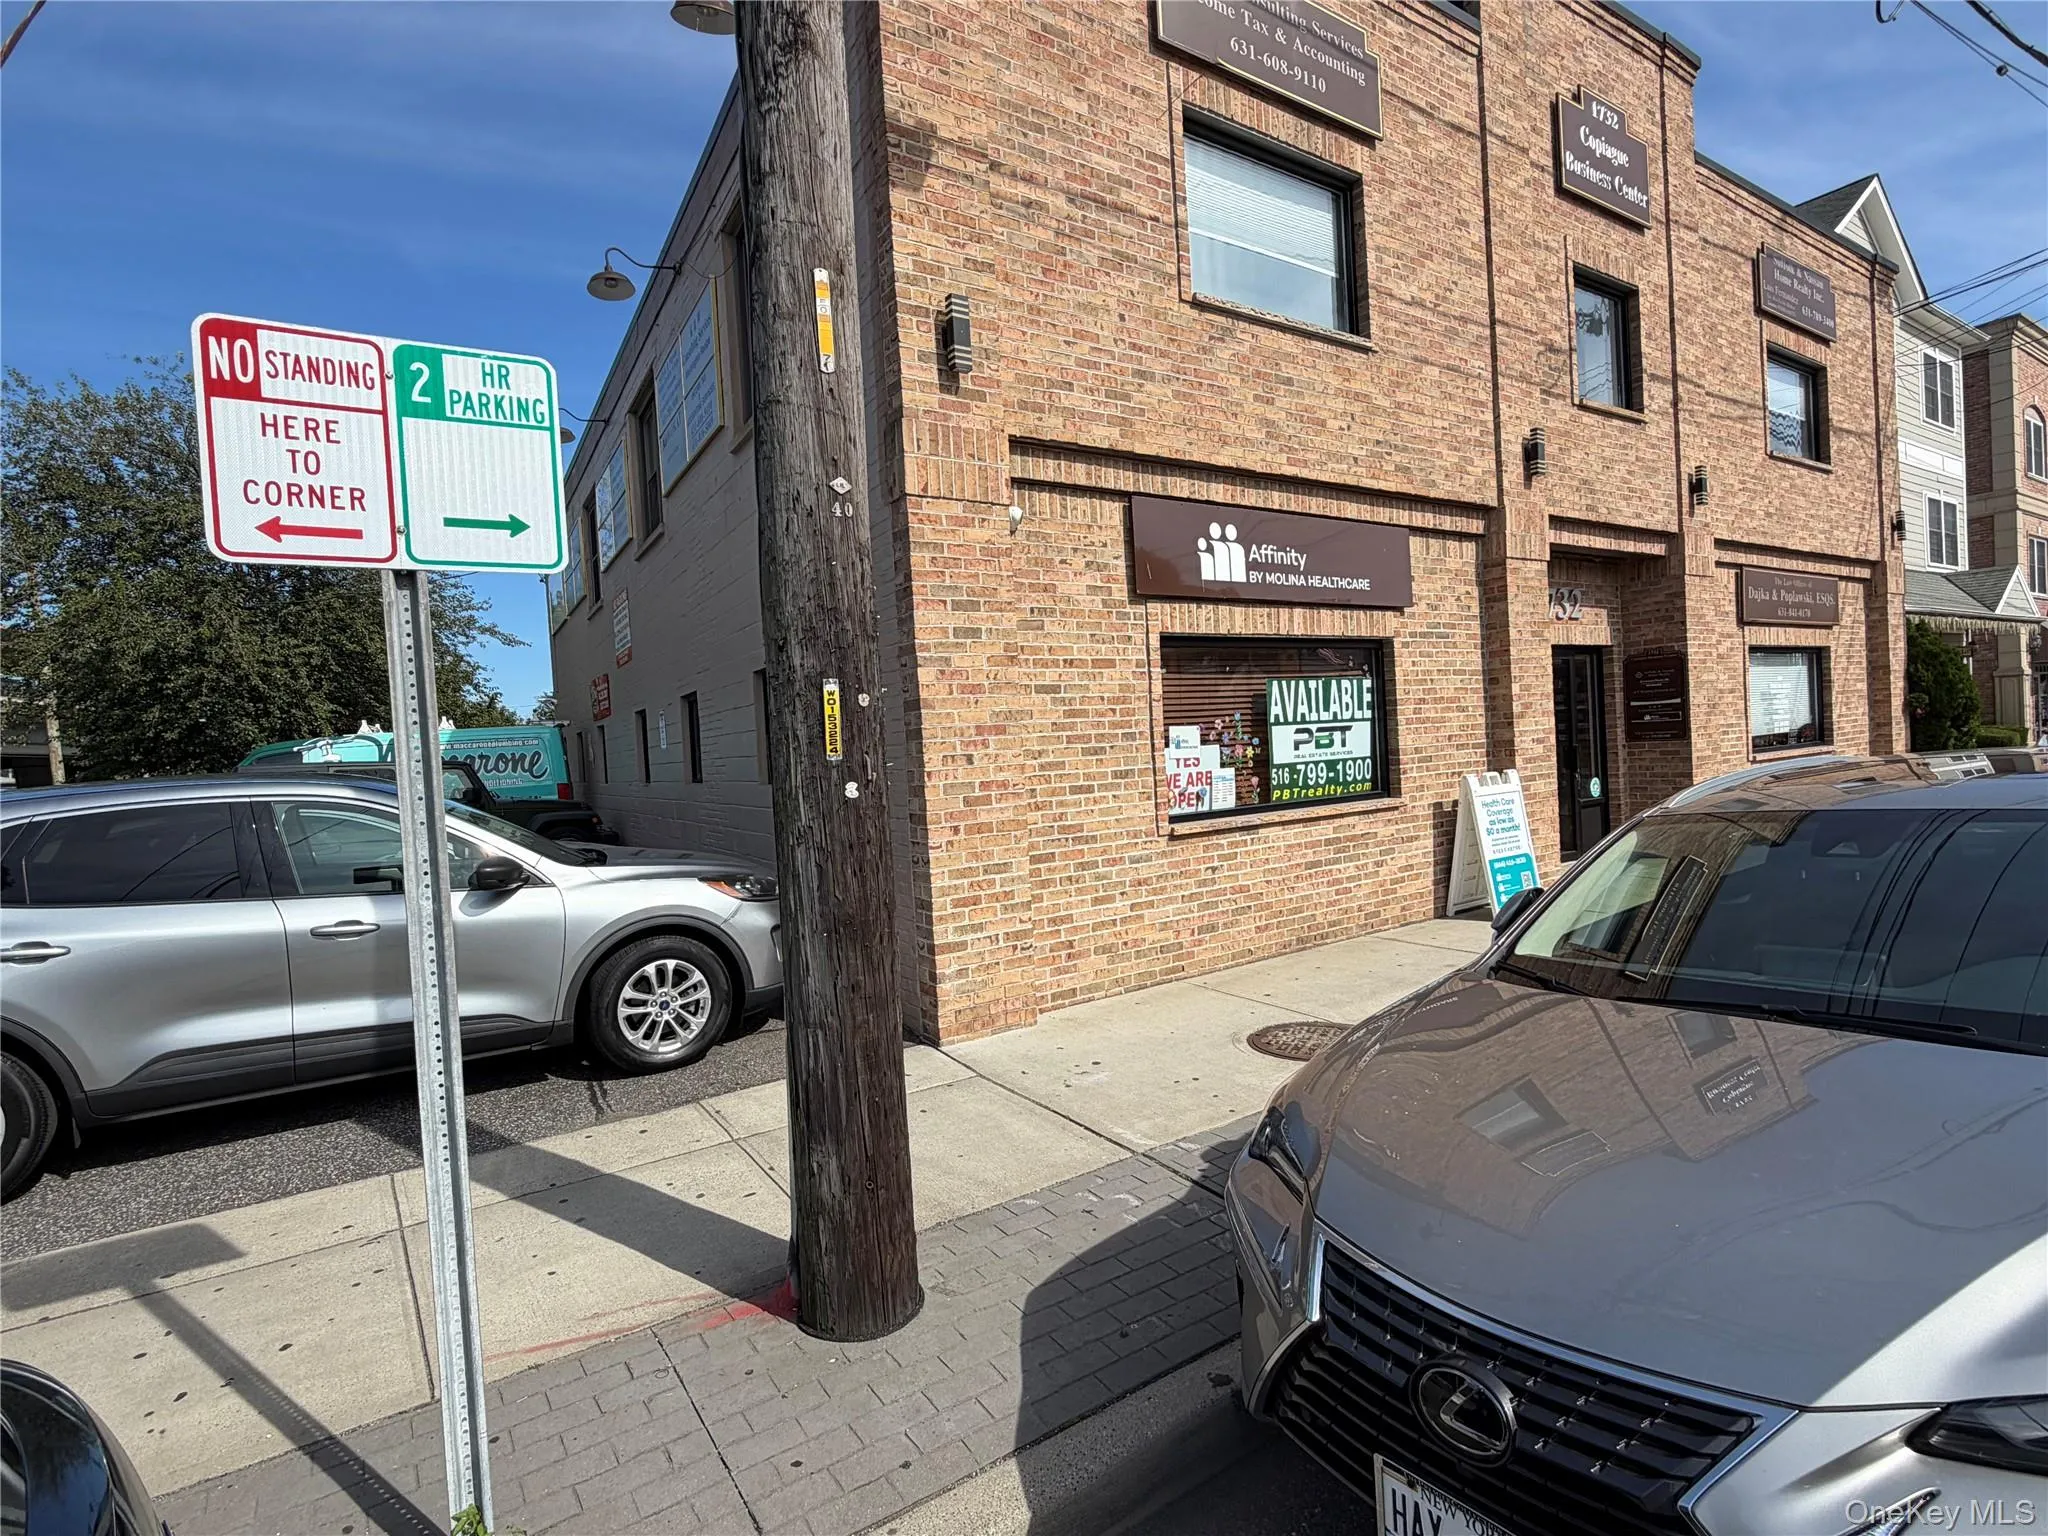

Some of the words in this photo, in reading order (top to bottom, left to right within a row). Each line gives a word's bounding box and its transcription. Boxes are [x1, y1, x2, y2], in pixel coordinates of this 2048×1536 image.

[1240, 8, 1270, 37] Tax
[1275, 27, 1287, 45] &
[1293, 36, 1366, 87] Accounting
[1312, 19, 1364, 60] Services
[1230, 36, 1327, 94] 631-608-9110
[1591, 100, 1619, 130] 1732
[1580, 125, 1630, 168] Copiague
[1565, 151, 1612, 191] Business
[1614, 175, 1649, 208] Center
[1793, 278, 1811, 299] Realty
[207, 335, 255, 383] NO
[265, 350, 376, 391] STANDING
[481, 361, 510, 390] HR
[409, 361, 432, 403] 2
[449, 389, 546, 425] PARKING
[259, 412, 341, 445] HERE
[285, 449, 321, 475] TO
[243, 479, 367, 512] CORNER
[831, 502, 853, 517] 40
[1249, 544, 1307, 571] Affinity
[1249, 571, 1263, 584] BY
[1266, 572, 1306, 587] MOLINA
[1308, 575, 1371, 591] HEALTHCARE
[1748, 586, 1770, 602] Dajka
[1772, 588, 1778, 600] &
[1270, 679, 1372, 722] AVAILABLE
[1293, 725, 1353, 751] PBT
[1272, 781, 1372, 801] PBTrealty.com
[1481, 800, 1501, 809] Health
[1501, 797, 1515, 806] Care
[1486, 807, 1513, 818] Coverage
[1496, 817, 1507, 825] low
